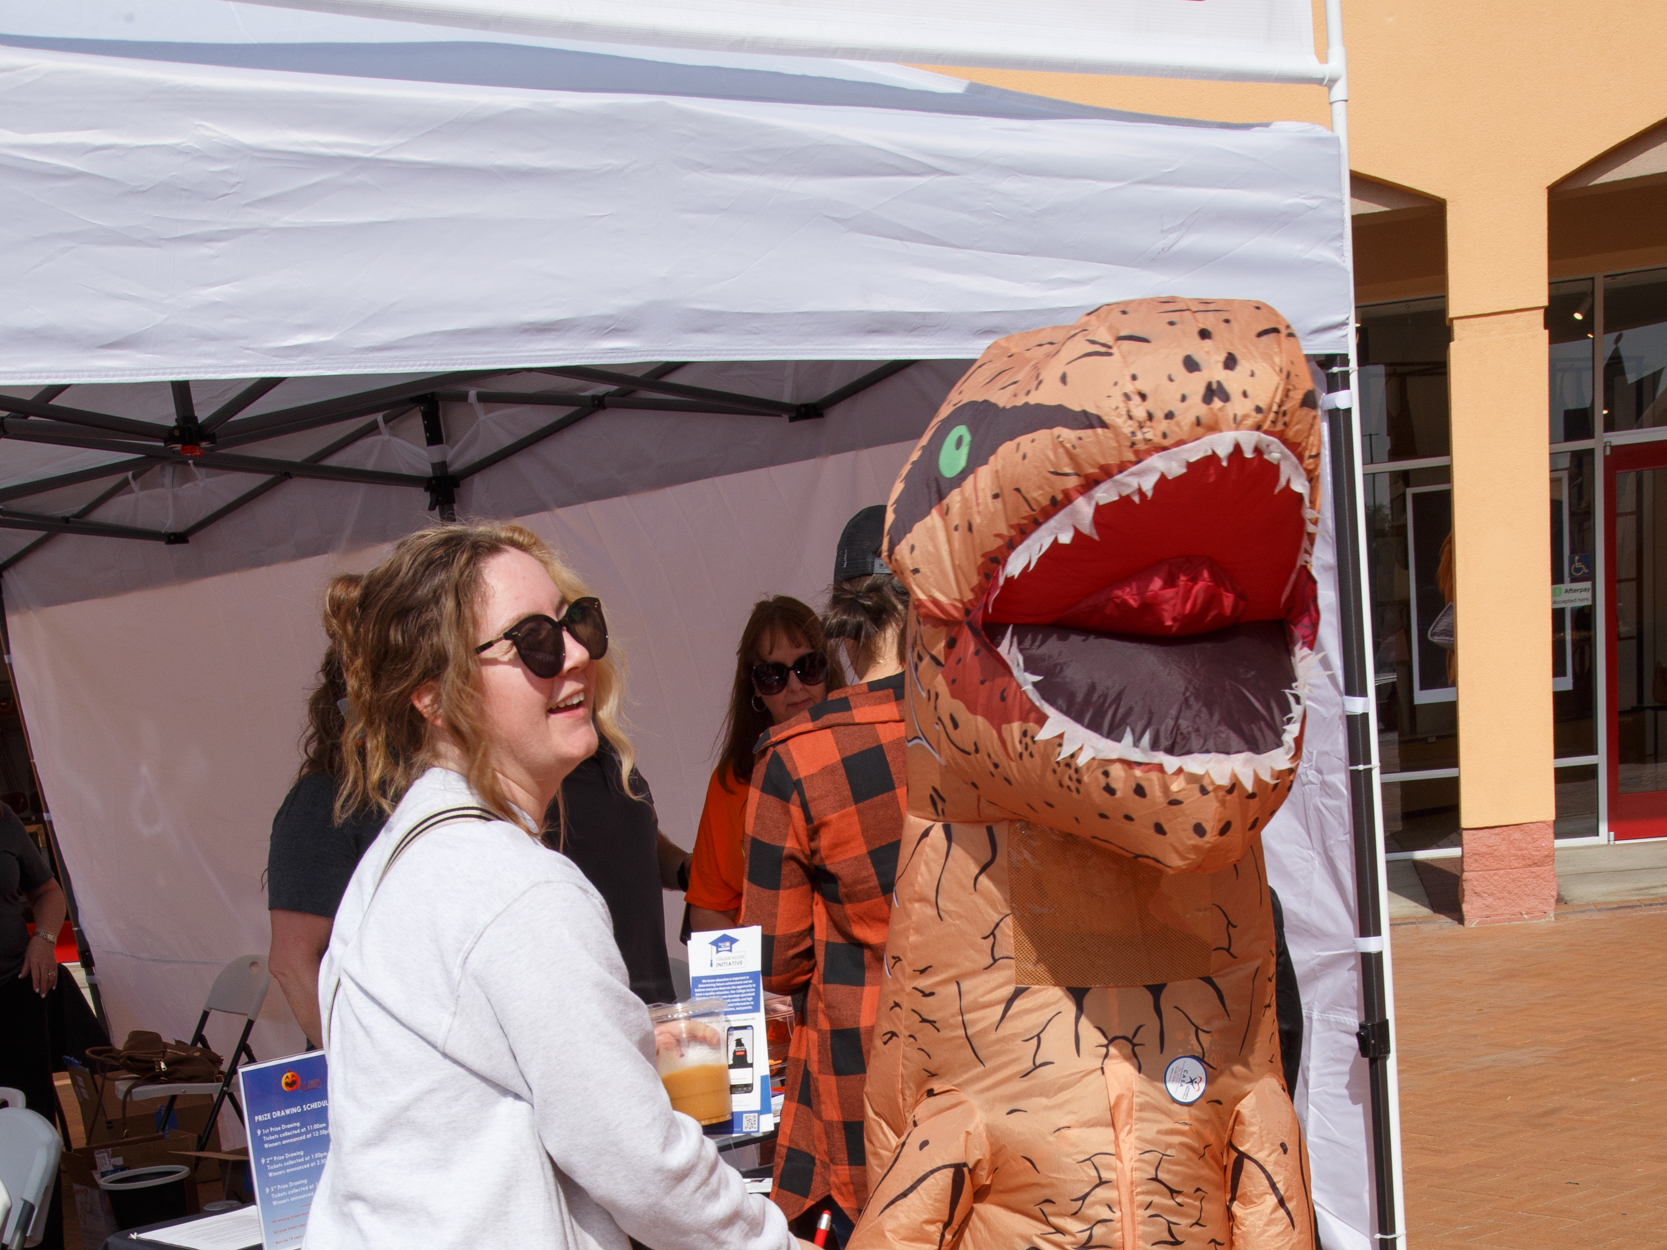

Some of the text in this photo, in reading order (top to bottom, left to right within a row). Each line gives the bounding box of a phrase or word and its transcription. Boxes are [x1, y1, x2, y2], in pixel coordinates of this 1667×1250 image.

[1180, 1070, 1188, 1087] CASA
[255, 1100, 329, 1122] PRIZE DRAWING SCHEDUL
[263, 1133, 278, 1141] Tickets
[280, 1129, 300, 1138] collected
[307, 1123, 327, 1131] 11:00am
[282, 1135, 305, 1144] announced
[267, 1162, 282, 1170] Tickets
[284, 1157, 304, 1166] collected
[286, 1164, 310, 1173] announced
[272, 1191, 287, 1199] Tickets
[288, 1186, 308, 1194] collected
[290, 1191, 314, 1201] announced
